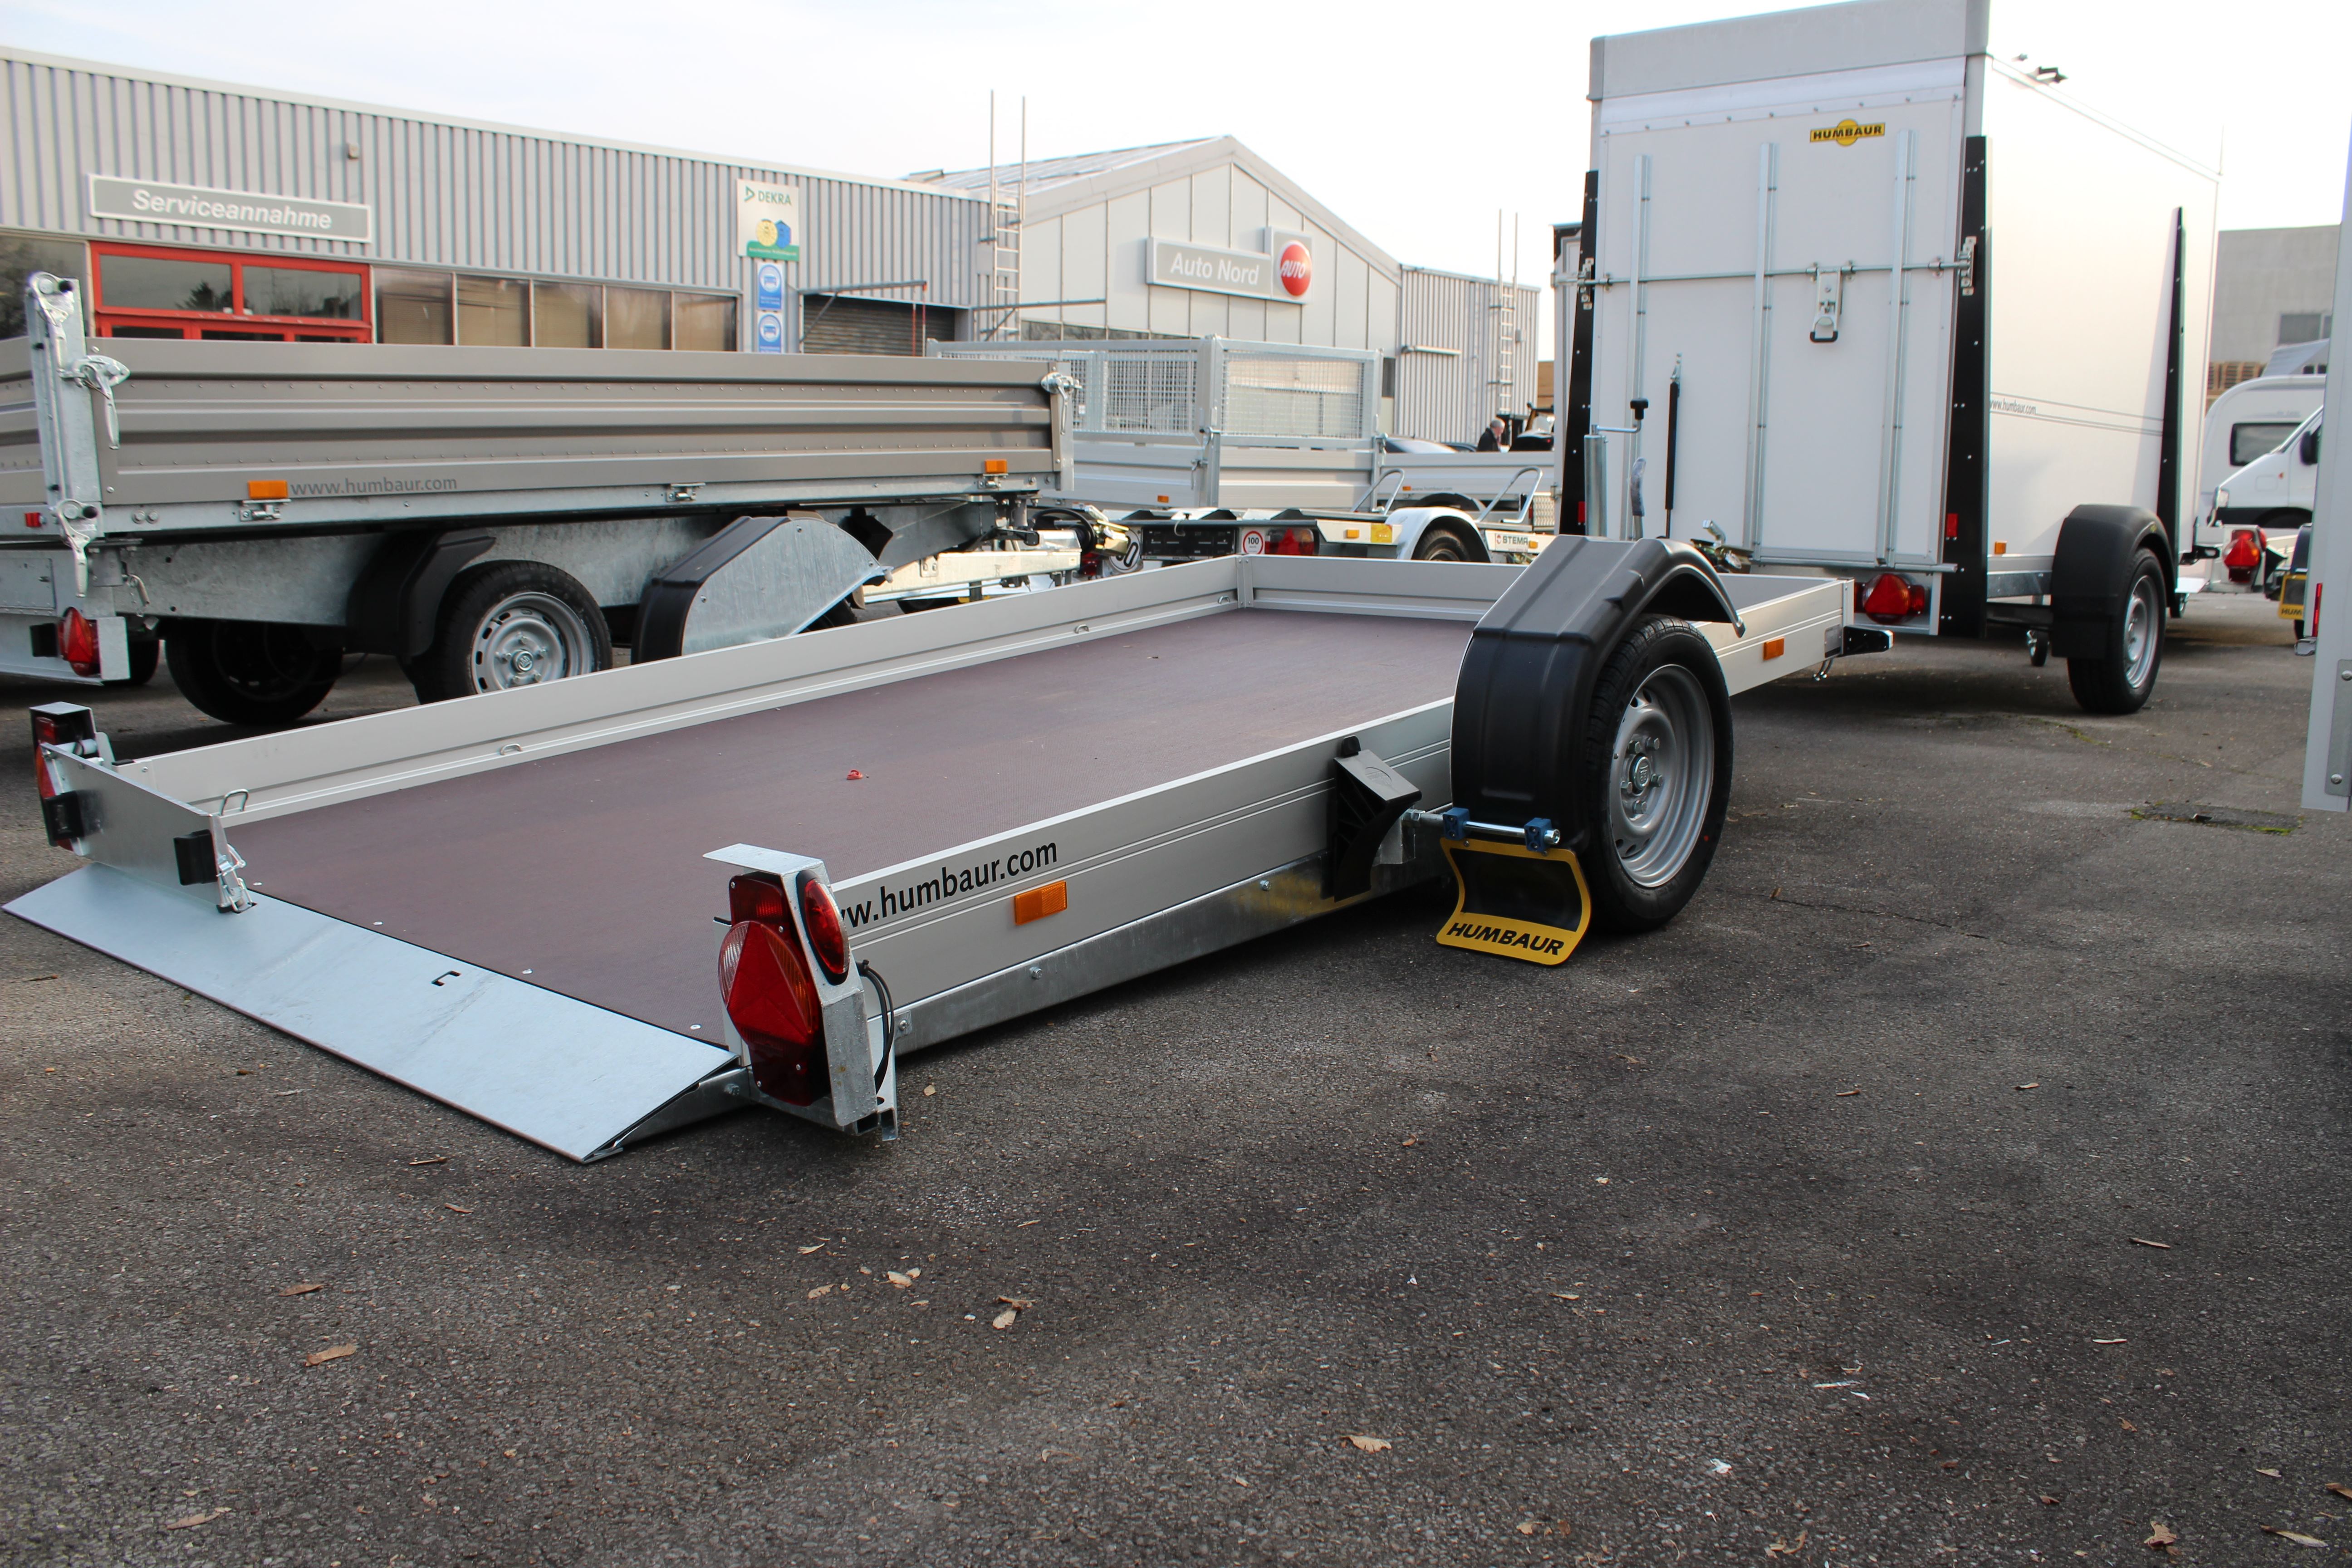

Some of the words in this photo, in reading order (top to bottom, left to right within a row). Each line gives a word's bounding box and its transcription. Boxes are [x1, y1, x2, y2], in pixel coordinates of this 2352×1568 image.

[1813, 125, 1882, 139] HUMBAUR
[758, 190, 792, 206] DEKRA
[132, 188, 333, 229] Serviceannahme
[1170, 253, 1213, 279] Auto
[1218, 260, 1260, 285] Nord
[1281, 260, 1306, 279] AUTO
[290, 477, 457, 495] www.humbaur.com
[1446, 922, 1564, 956] HUMBAUR
